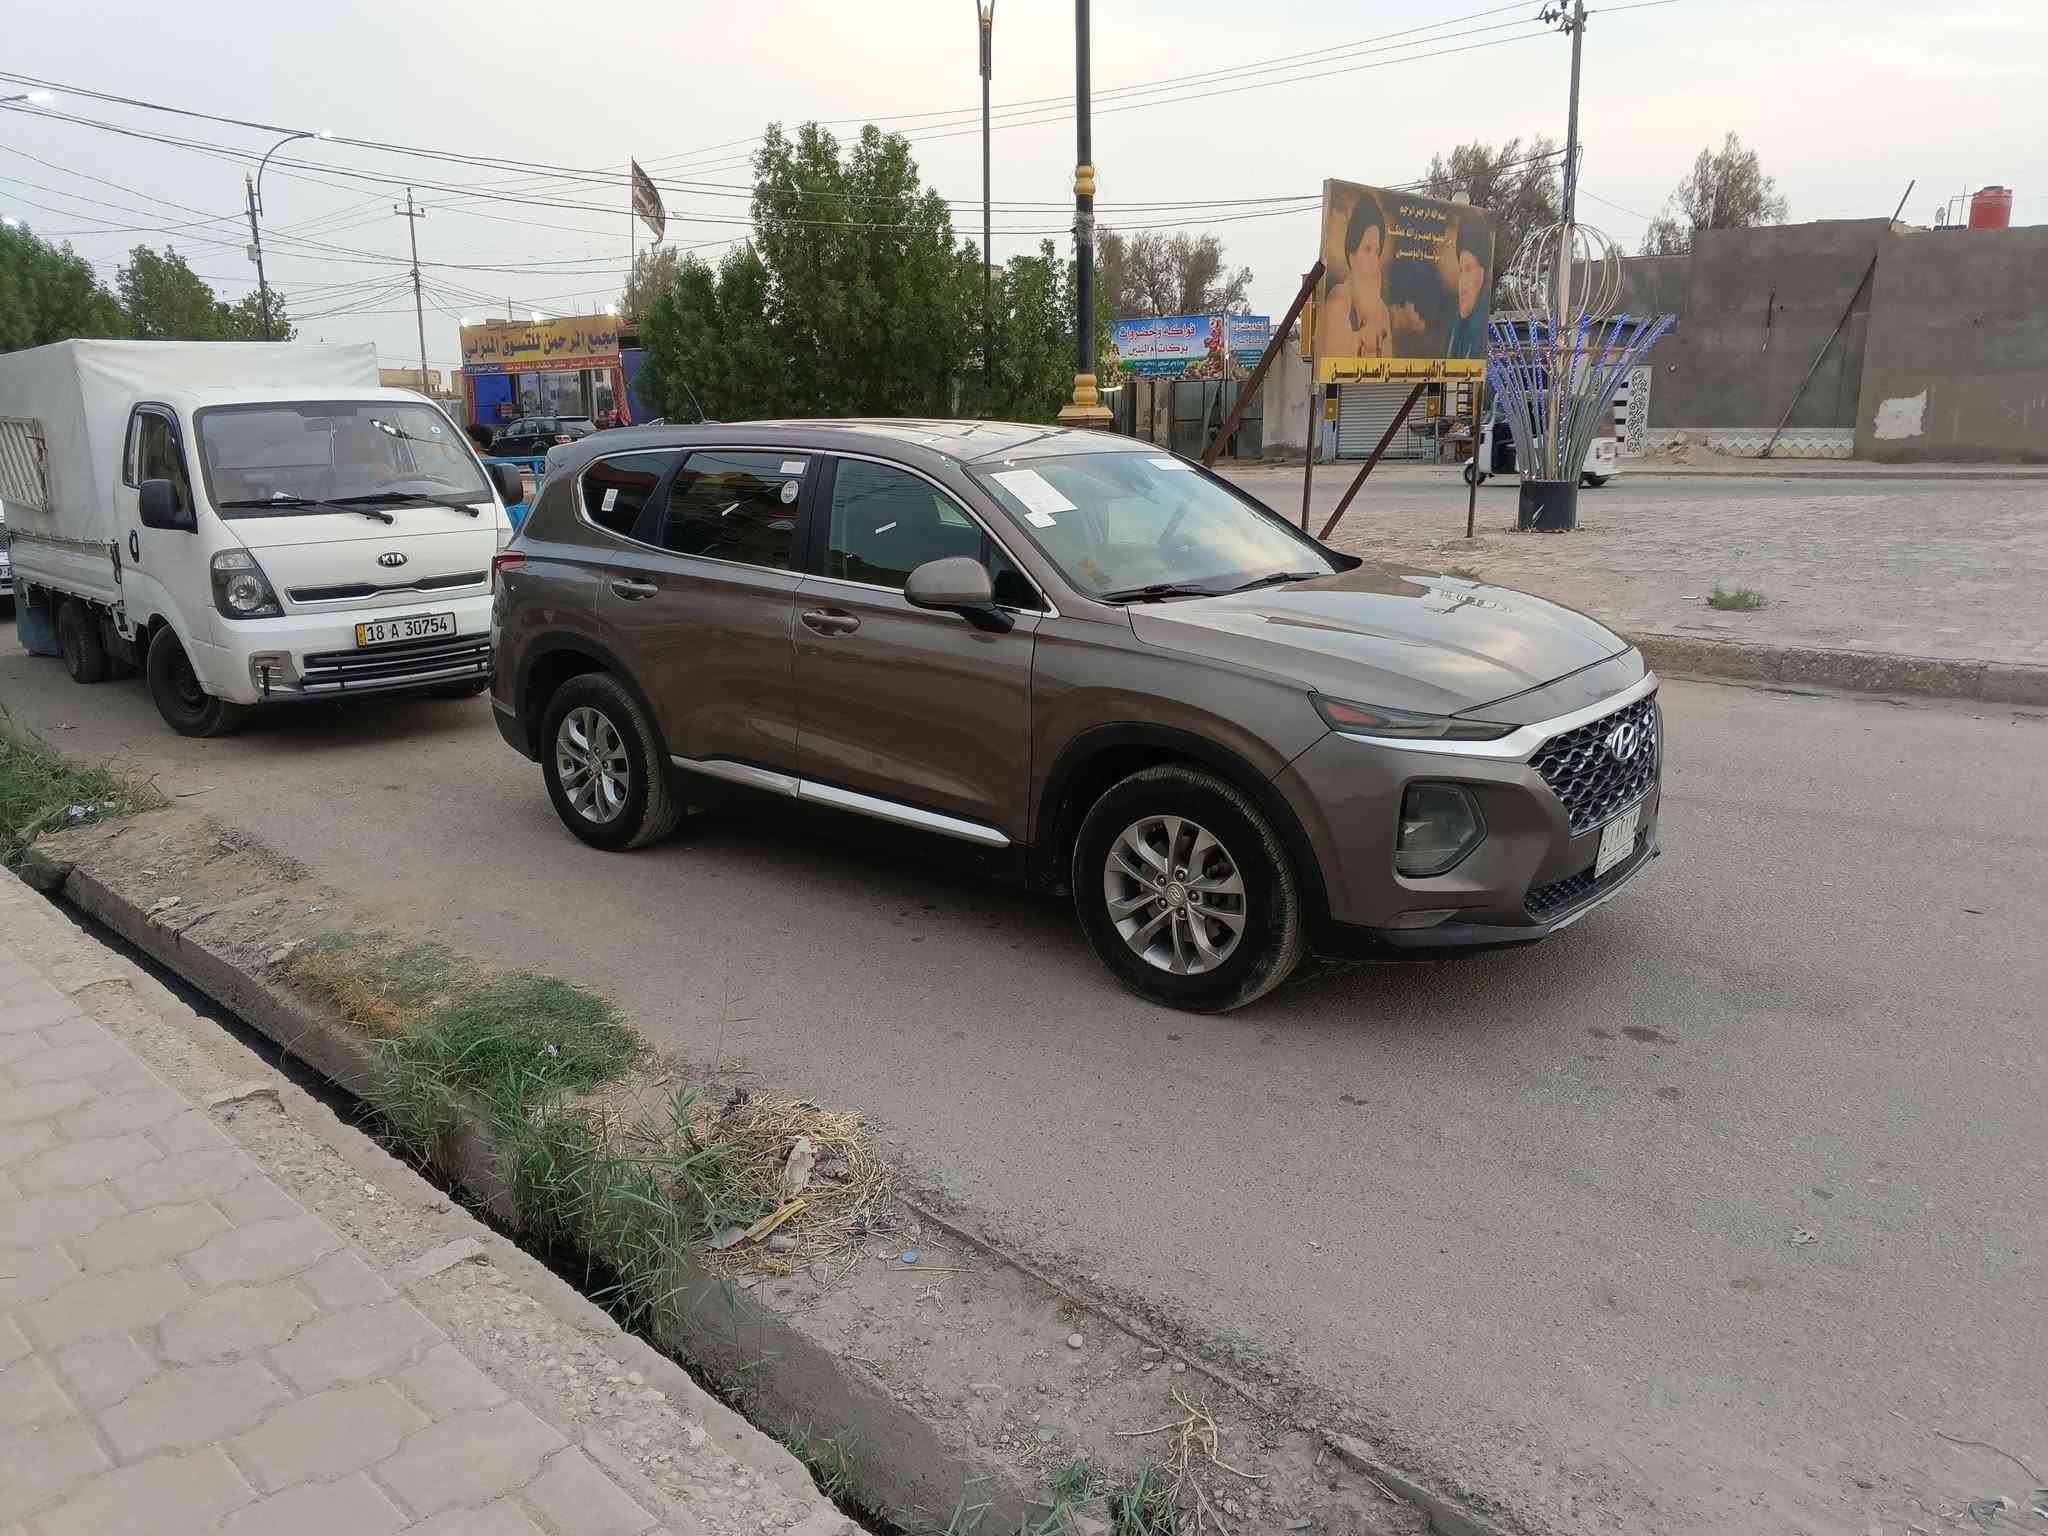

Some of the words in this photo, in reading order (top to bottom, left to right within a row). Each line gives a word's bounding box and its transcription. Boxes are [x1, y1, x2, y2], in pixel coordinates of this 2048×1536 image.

[464, 335, 499, 363] المنزلي
[502, 333, 540, 356] للتسوق
[543, 330, 585, 355] الرحمن
[381, 553, 405, 564] KIA
[367, 625, 384, 640] 18
[391, 624, 400, 638] A
[404, 617, 448, 636] 30754
